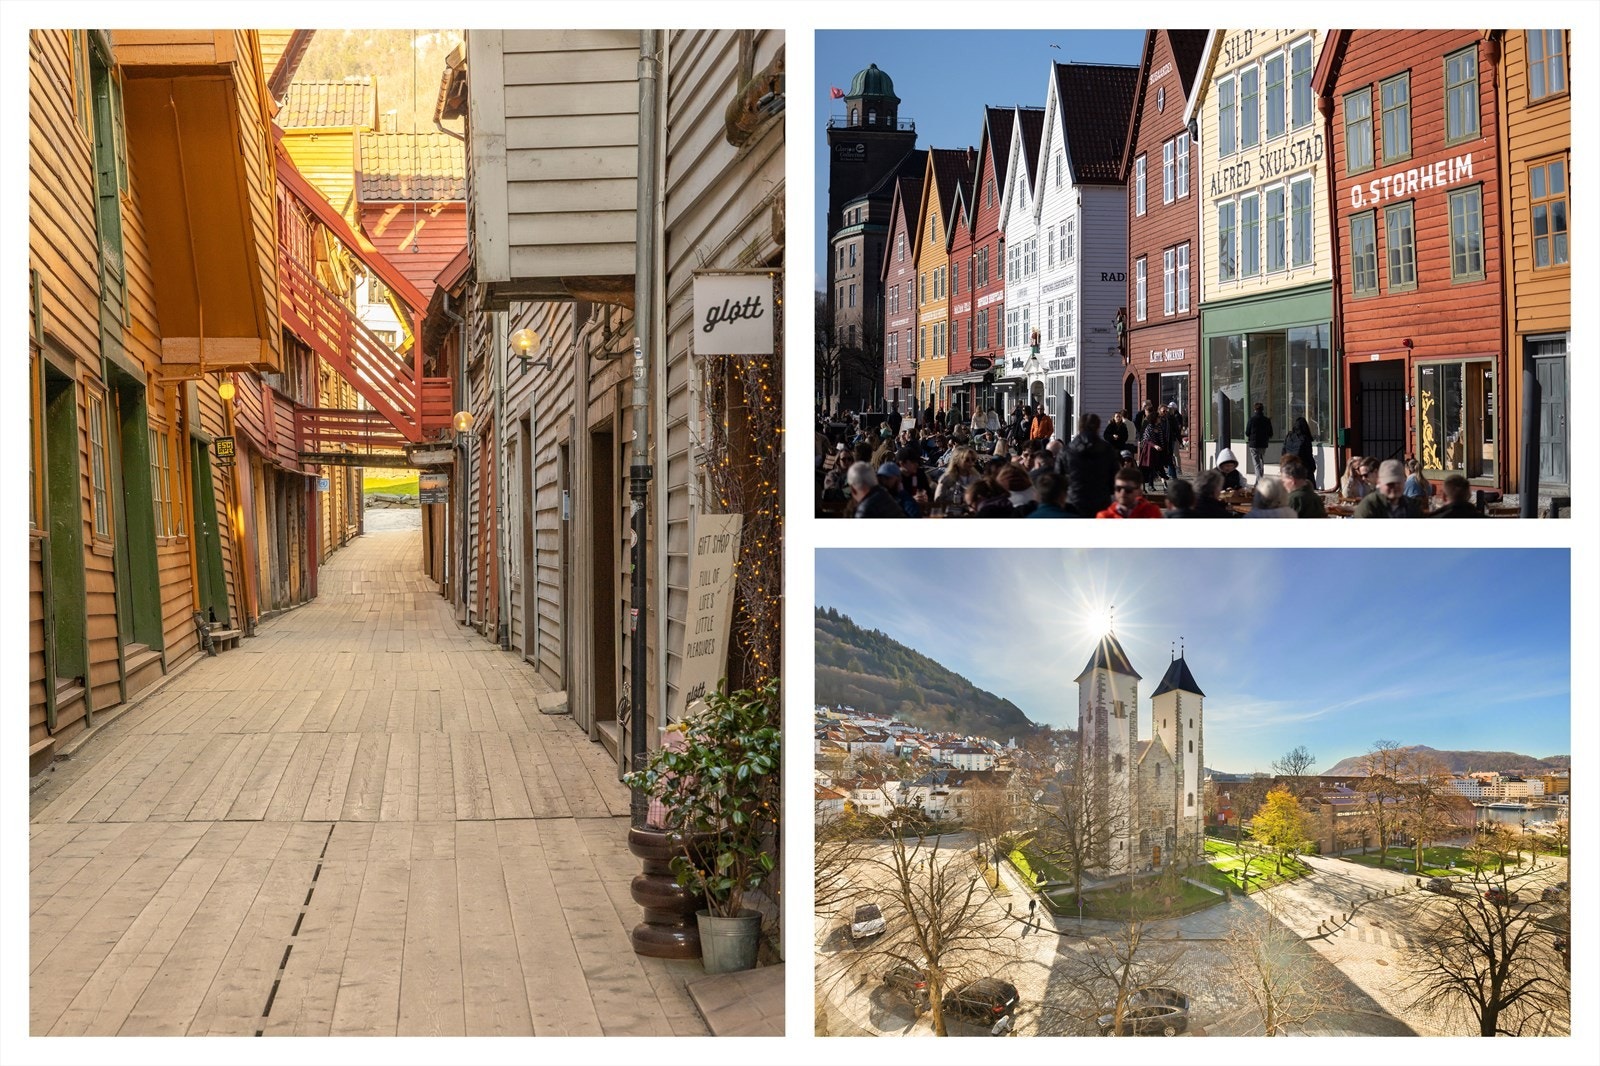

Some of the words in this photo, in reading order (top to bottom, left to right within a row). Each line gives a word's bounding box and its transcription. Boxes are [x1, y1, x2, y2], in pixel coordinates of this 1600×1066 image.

[1210, 160, 1251, 197] ALFRED
[1259, 133, 1324, 181] SKULSTAD
[697, 534, 712, 556] GIFT
[712, 533, 730, 554] SHOP
[700, 570, 711, 587] FULL
[695, 615, 715, 635] LITTLE
[686, 638, 715, 659] PLEASURES
